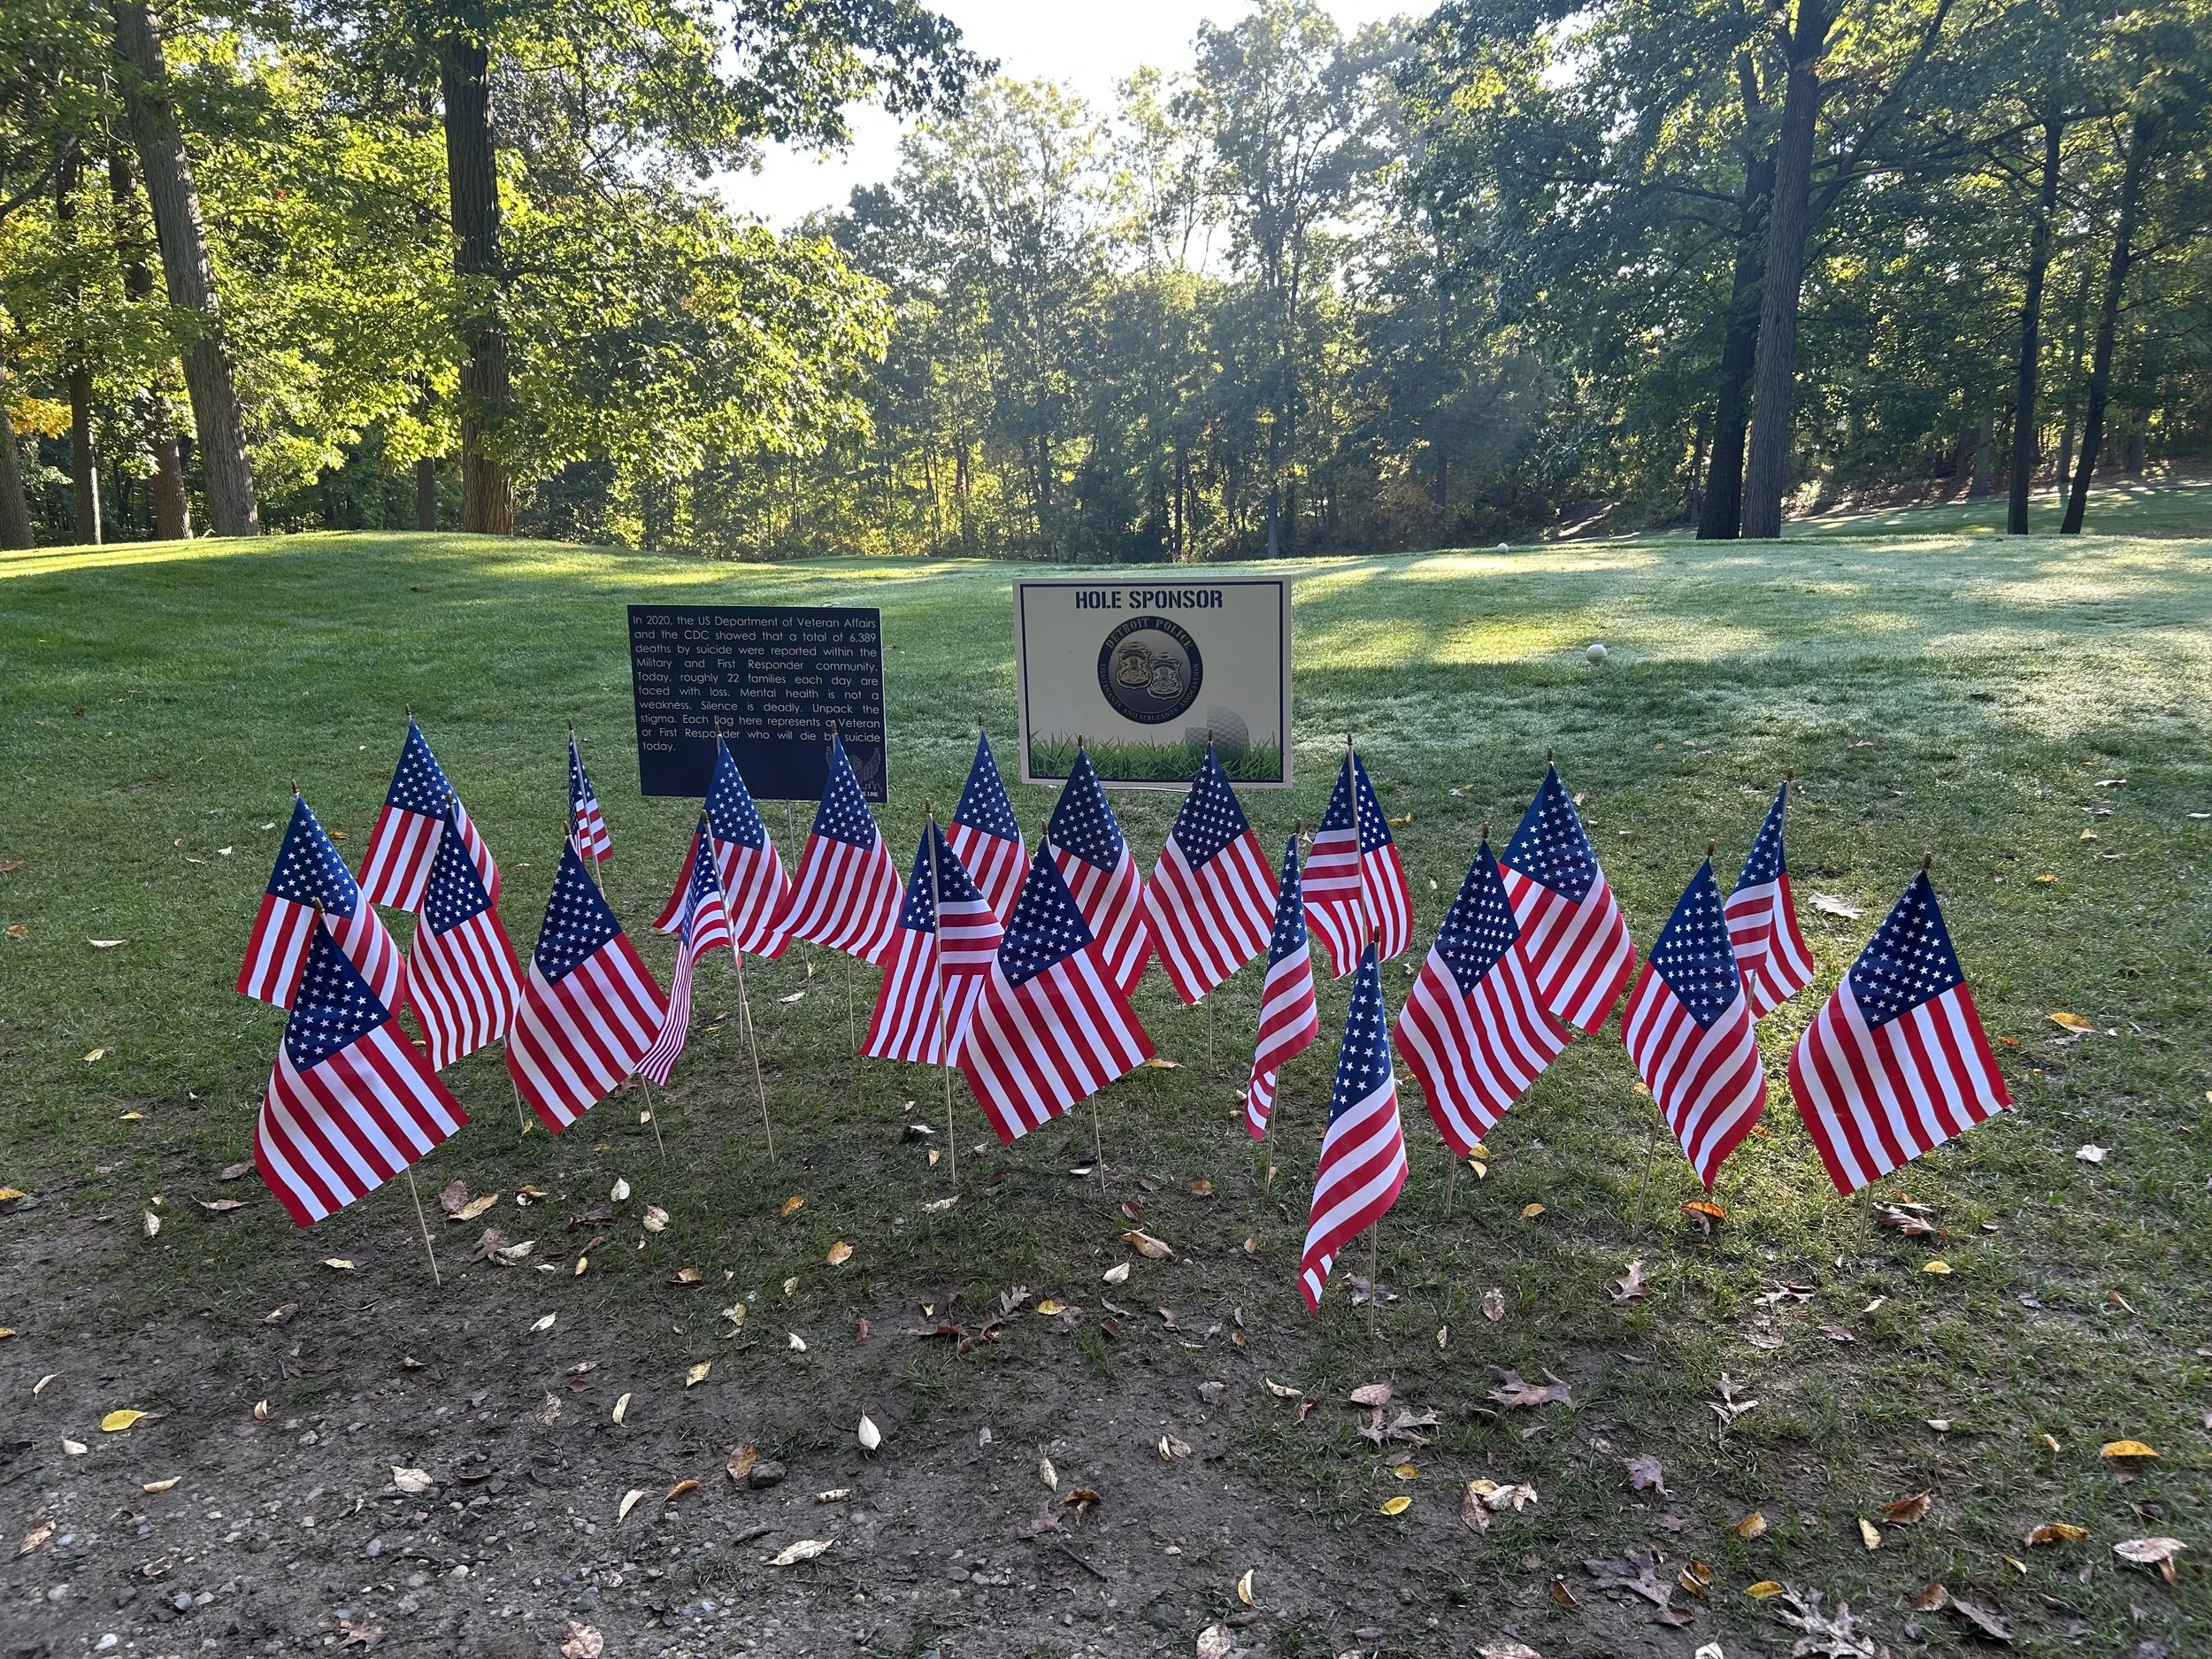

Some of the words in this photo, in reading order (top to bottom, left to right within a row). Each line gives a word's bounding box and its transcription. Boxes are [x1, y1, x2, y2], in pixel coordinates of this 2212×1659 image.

[1076, 591, 1122, 609] HOLE
[1129, 590, 1223, 609] SPONSOR
[633, 615, 642, 624] In
[646, 615, 672, 626] 2020,
[677, 616, 695, 626] the
[697, 616, 710, 626] US
[714, 616, 778, 628] Department
[782, 617, 793, 627] of
[796, 617, 840, 628] Veteran
[843, 618, 876, 628] Affairs
[634, 629, 656, 639] and
[661, 629, 679, 640] the
[684, 629, 710, 641] CDC
[715, 630, 757, 641] showed
[762, 631, 783, 641] that
[803, 632, 827, 642] total
[832, 632, 843, 642] of
[849, 633, 877, 643] 6,389
[1106, 617, 1149, 649] DETROIT
[1156, 618, 1194, 649] POLICE
[635, 643, 672, 654] deaths
[676, 644, 690, 656] by
[695, 644, 733, 655] suicide
[738, 647, 765, 656] were
[771, 646, 817, 657] reported
[822, 646, 854, 657] within
[859, 647, 878, 657] the
[636, 657, 672, 669] Military
[684, 658, 705, 668] and
[717, 658, 735, 669] First
[748, 659, 804, 672] Responder
[815, 661, 878, 673] community.
[637, 672, 672, 683] Today,
[680, 672, 718, 685] roughly
[726, 672, 740, 683] 22
[748, 672, 787, 684] families
[795, 675, 823, 685] each
[831, 675, 852, 687] day
[860, 678, 879, 687] are
[638, 685, 670, 695] faced
[679, 686, 701, 695] with
[710, 687, 731, 697] loss.
[740, 687, 777, 698] Mental
[785, 688, 819, 699] health
[827, 689, 835, 699] is
[844, 690, 862, 700] not
[871, 692, 879, 701] a
[1122, 708, 1138, 718] AND
[1139, 708, 1179, 721] SERGEANTS
[1179, 663, 1202, 708] ASSOCIATION
[639, 700, 692, 710] weakness.
[701, 700, 738, 711] Silence
[747, 702, 755, 711] is
[763, 702, 803, 714] deadly.
[812, 703, 853, 715] Unpack
[862, 704, 879, 715] the
[640, 713, 678, 726] stigma.
[682, 714, 709, 724] Each
[713, 714, 734, 726] flag
[738, 715, 763, 726] here
[767, 717, 821, 727] represents
[837, 718, 880, 728] Veteran
[659, 727, 677, 738] First
[747, 729, 770, 740] who
[776, 730, 793, 740] will
[800, 731, 817, 741] die
[844, 732, 881, 742] suicide
[642, 741, 676, 753] today.
